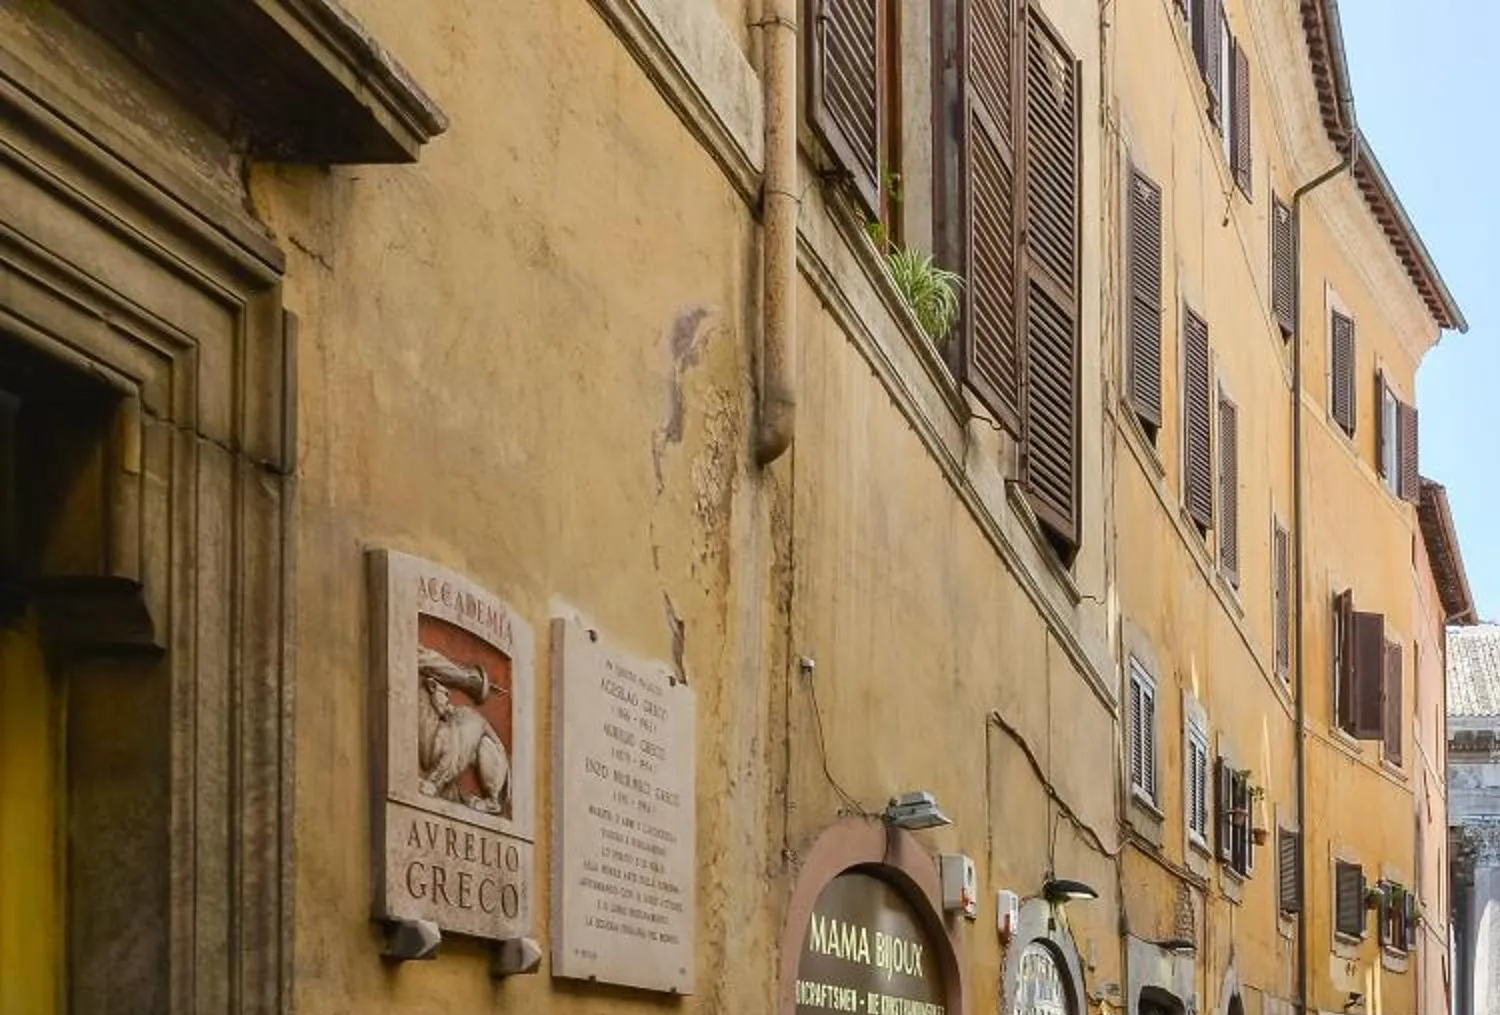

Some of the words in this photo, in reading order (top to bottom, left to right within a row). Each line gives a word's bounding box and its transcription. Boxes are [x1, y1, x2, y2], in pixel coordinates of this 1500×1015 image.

[417, 575, 513, 652] ACCADEMIA
[407, 820, 519, 873] AVRELIO
[405, 861, 519, 920] GRECO
[809, 911, 871, 965] MAMA
[874, 931, 923, 982] BIJOUX
